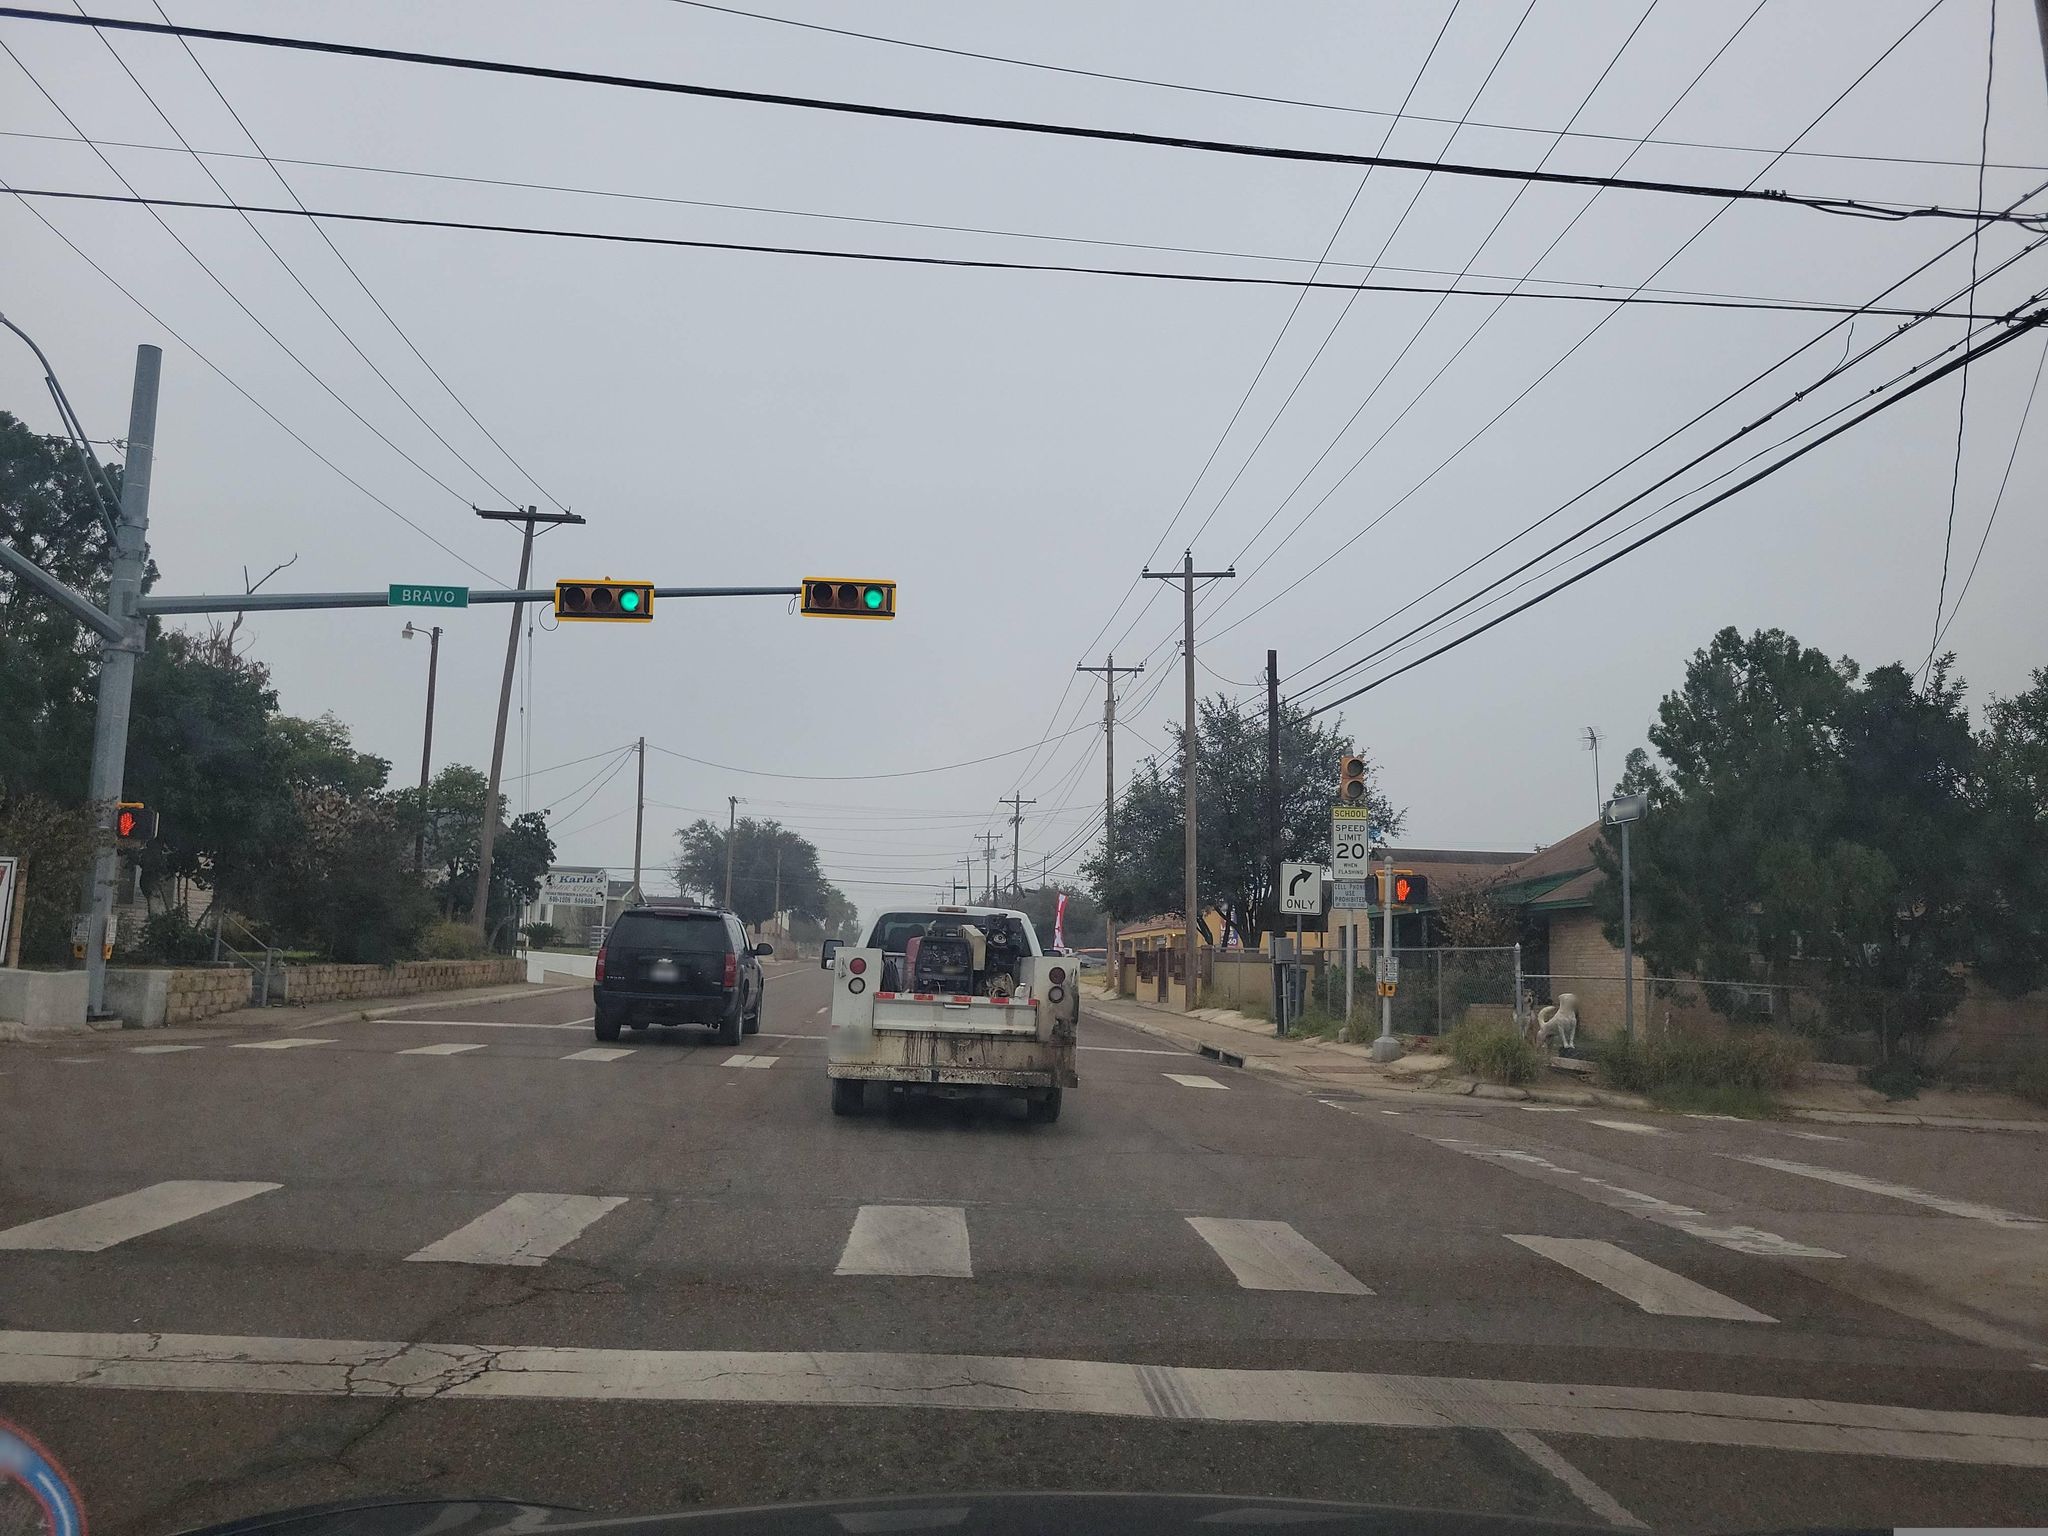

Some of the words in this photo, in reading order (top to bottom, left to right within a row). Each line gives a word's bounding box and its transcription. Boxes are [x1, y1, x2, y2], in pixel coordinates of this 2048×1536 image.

[402, 589, 455, 603] BRAVO
[1334, 810, 1366, 818] SCHOOL
[1335, 824, 1366, 832] SPEED
[1336, 843, 1365, 859] 20
[559, 875, 604, 884] Karla's
[1286, 899, 1315, 909] ONLY
